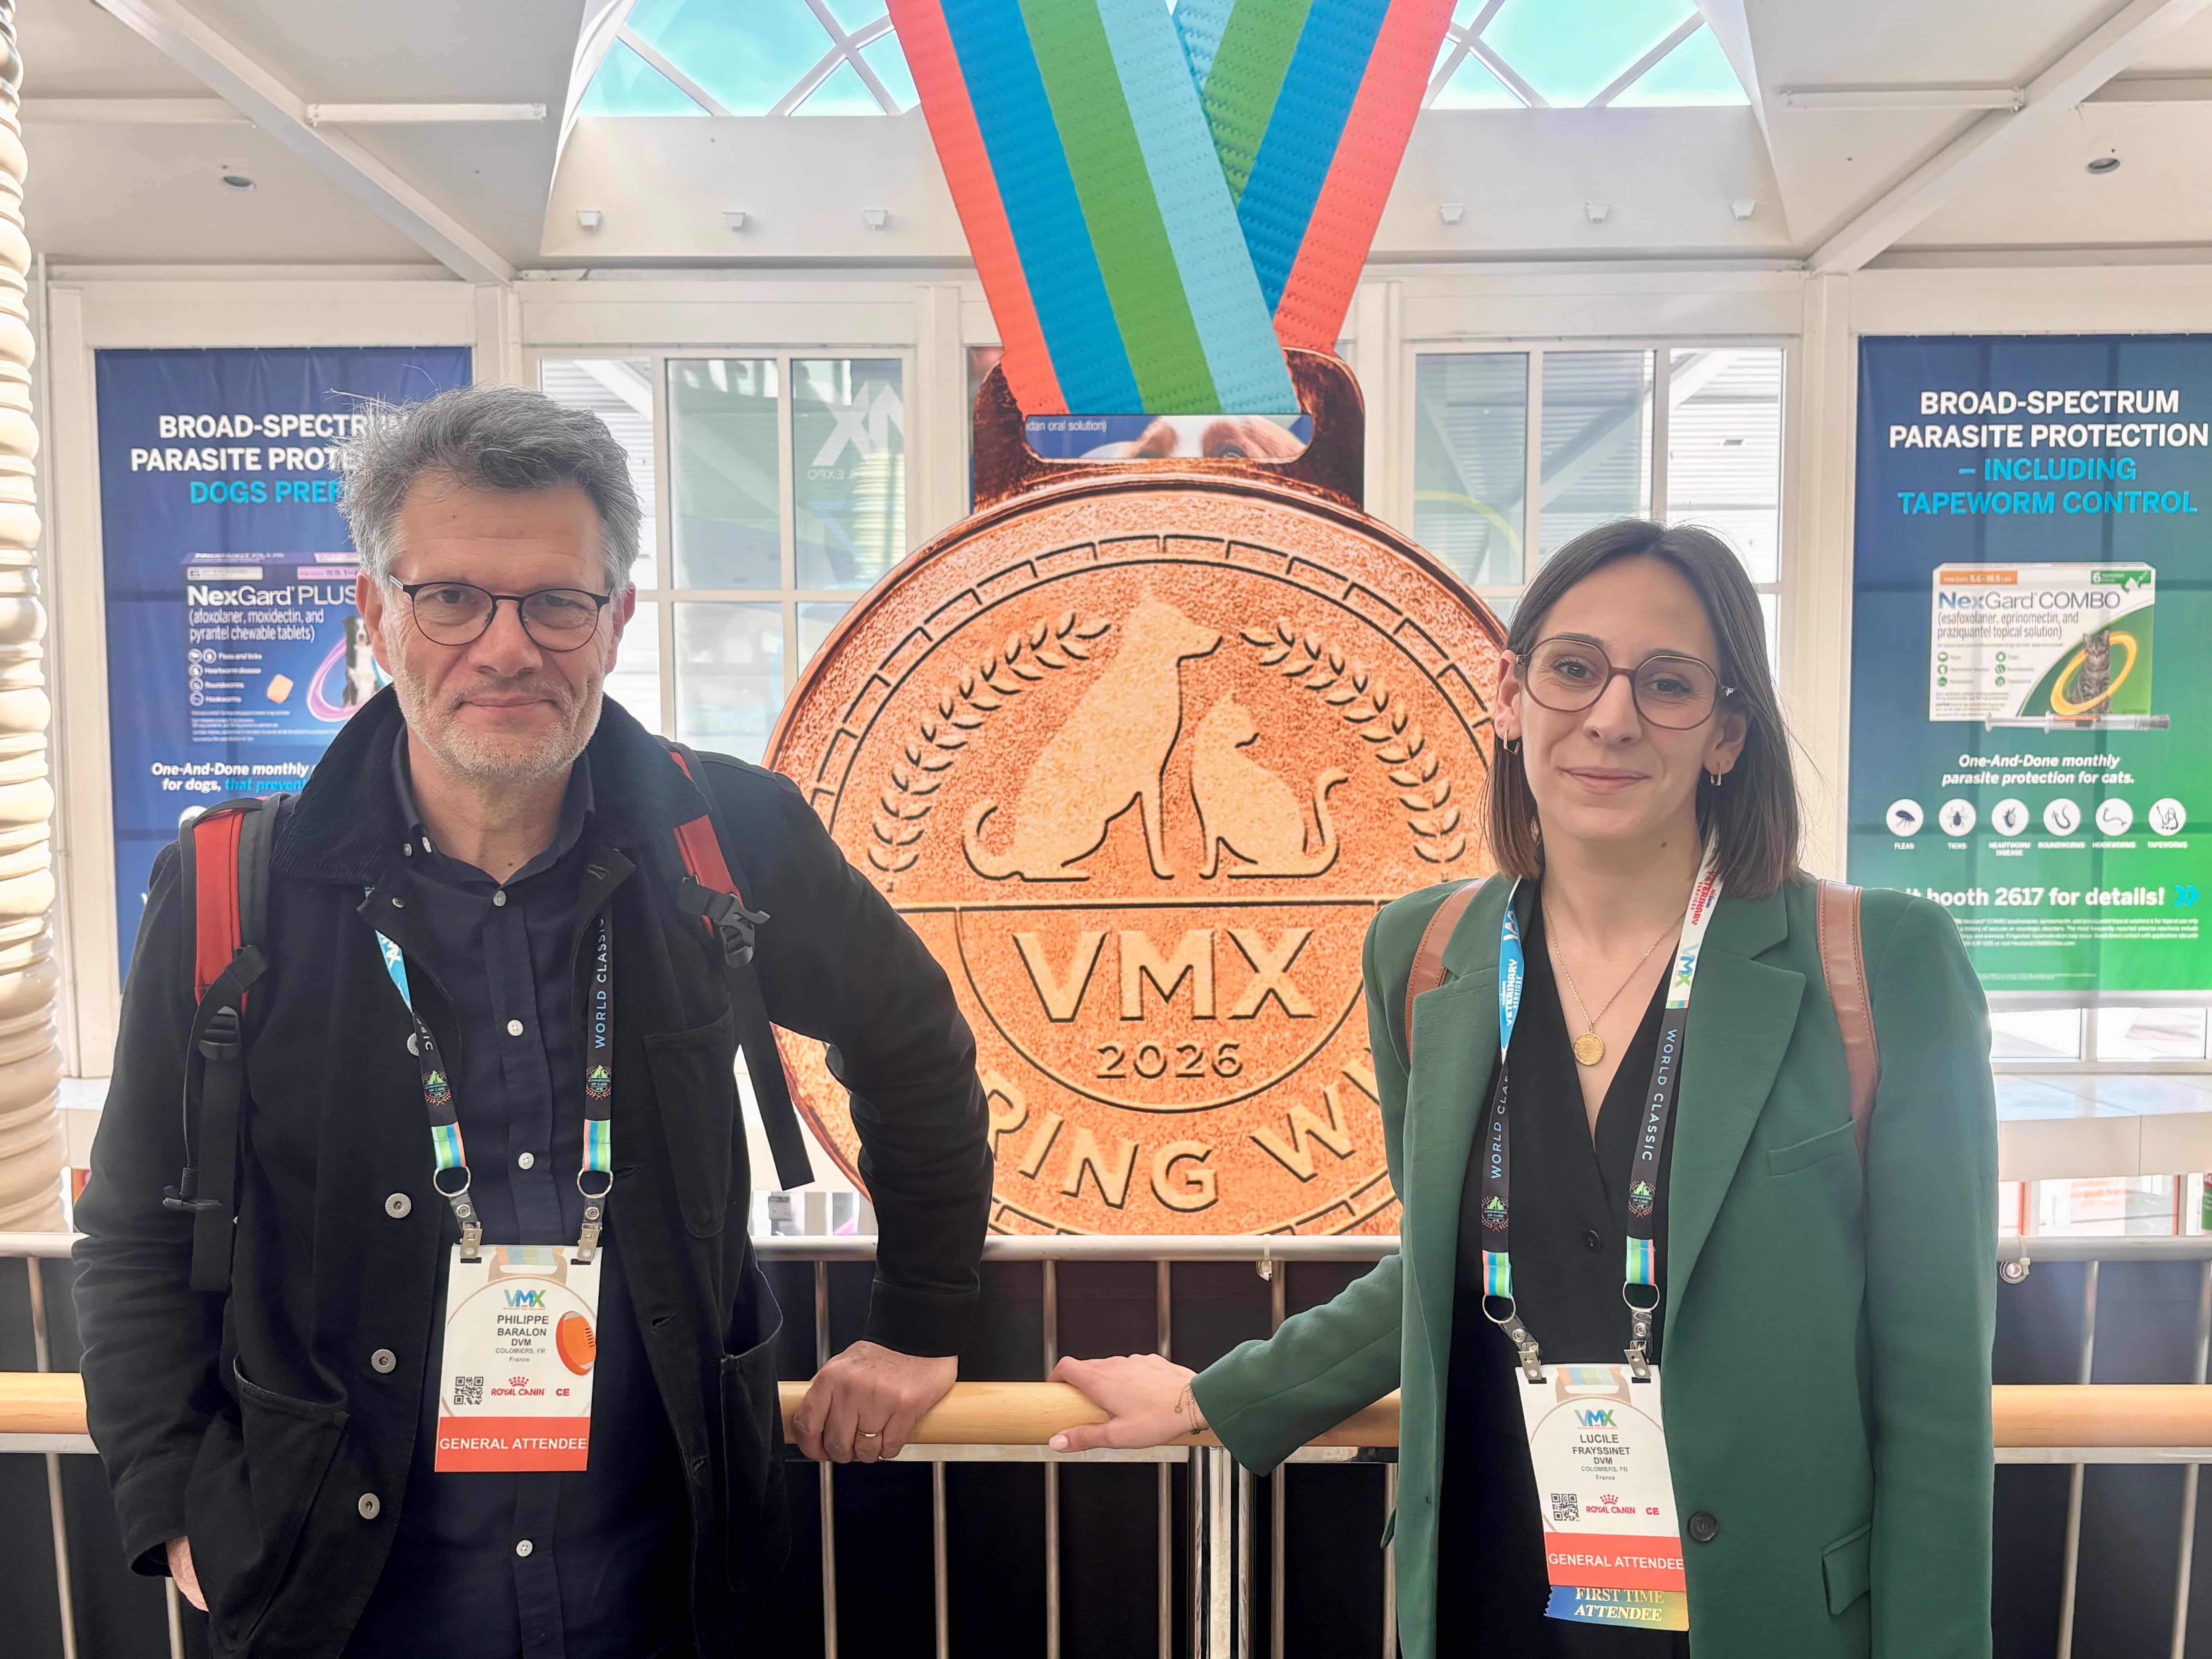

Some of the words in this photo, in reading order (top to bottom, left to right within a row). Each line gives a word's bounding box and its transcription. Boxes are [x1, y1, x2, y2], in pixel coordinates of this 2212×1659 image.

[1920, 390, 2179, 415] BROAD-SPECTRUM
[159, 414, 368, 438] BROAD-SPECTR
[1047, 420, 1066, 431] oral
[1068, 420, 1107, 433] solution)
[1889, 425, 2023, 448] PARASITE
[2030, 424, 2209, 448] PROTECTION
[131, 448, 262, 472] PARASITE
[1984, 458, 2136, 481] INCLUDING
[191, 481, 267, 504] DOGS
[1897, 491, 2055, 515] TAPEWORM
[2063, 491, 2198, 514] CONTROL
[2093, 572, 2101, 583] 6
[299, 585, 356, 606] PLUS
[2039, 591, 2120, 610] COMBO
[305, 608, 324, 624] and
[2063, 612, 2078, 624] and
[189, 625, 229, 643] pyrantel
[231, 625, 276, 641] chewable
[277, 625, 315, 642] tablets)
[1937, 626, 1992, 641] praziquantel
[1993, 626, 2021, 639] topical
[2024, 626, 2062, 639] solution)
[151, 762, 249, 776] One-And-Done
[252, 762, 310, 778] monthly
[1958, 754, 2059, 768] One-And-Done
[2061, 754, 2121, 769] monthly
[161, 777, 183, 791] for
[185, 778, 222, 793] dogs,
[225, 778, 252, 791] that
[1942, 771, 1999, 787] parasite
[2001, 771, 2074, 787] protection
[2078, 771, 2099, 784] for
[2101, 771, 2135, 784] cats.
[1894, 842, 1915, 850] FLEAS
[1927, 887, 1989, 906] booth
[1994, 887, 2044, 906] 2617
[2048, 887, 2080, 906] for
[2085, 887, 2165, 906] details!
[1675, 943, 1699, 988] VMX
[1011, 929, 1317, 1023] VMX
[1505, 958, 1518, 1027] VETERINARY
[595, 990, 606, 1049] WORLD
[1096, 1040, 1243, 1080] 2026
[1657, 1029, 1678, 1085] WORLD
[1642, 1092, 1664, 1161] CLASSIC
[1491, 1121, 1502, 1179] WORLD
[504, 1289, 546, 1308] VMX
[497, 1315, 549, 1324] PHILIPPE
[497, 1328, 546, 1336] BARALON
[556, 1388, 570, 1396] CE
[1574, 1409, 1618, 1427] VMX
[440, 1438, 509, 1449] GENERAL
[512, 1437, 587, 1450] ATTENDEE
[1580, 1434, 1619, 1443] LUCILE
[1572, 1446, 1630, 1455] FRAYSSINET
[1586, 1505, 1609, 1514] ROYAL
[1611, 1506, 1635, 1514] CANIN
[1645, 1507, 1659, 1515] CE
[1549, 1553, 1612, 1568] GENERAL
[1614, 1555, 1684, 1571] ATTENDEE
[1575, 1587, 1621, 1602] FIRST
[1623, 1589, 1664, 1604] TIME
[1573, 1604, 1662, 1622] ATTENDEE
